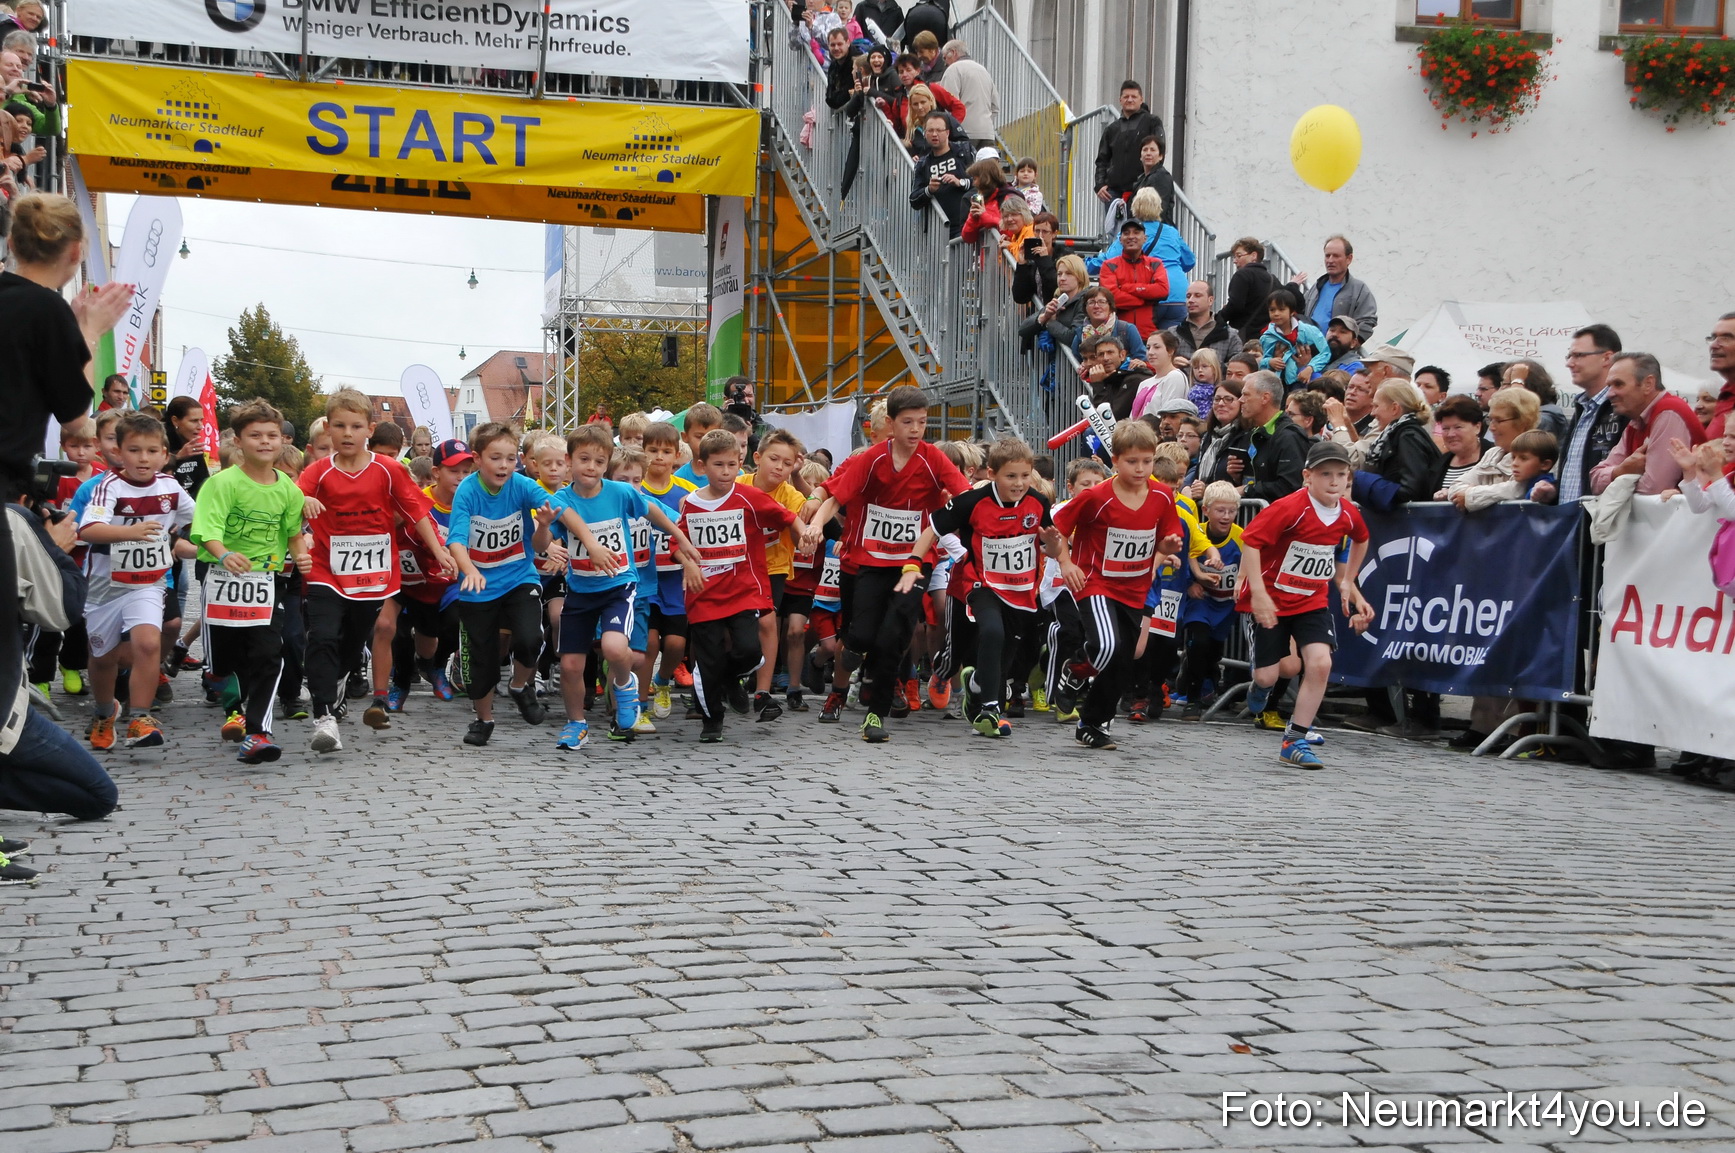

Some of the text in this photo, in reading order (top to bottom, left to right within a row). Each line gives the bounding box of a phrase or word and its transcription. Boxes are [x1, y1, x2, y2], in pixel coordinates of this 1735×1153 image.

[367, 23, 469, 46] Verbrauch.
[475, 31, 523, 50] Mehr
[108, 113, 265, 138] Neumarkter Stadtlauf
[306, 101, 542, 167] START
[582, 149, 722, 167] Neumarkter Stadtlauf
[930, 157, 957, 179] 952
[547, 187, 676, 205] Neumarkter Stadtlauf
[129, 281, 149, 330] BKK
[1488, 325, 1524, 337] UNS
[427, 417, 441, 444] BKK
[1089, 413, 1108, 437] BMW
[470, 519, 490, 530] PARTL
[707, 515, 735, 523] Neumarkt
[868, 508, 913, 521] PARTL Neumarkt
[475, 524, 520, 549] 7036
[693, 523, 742, 546] 7034
[870, 518, 916, 542] 7025
[1108, 531, 1129, 539] PARTL
[1002, 540, 1028, 550] Neumarkt
[1290, 544, 1311, 555] PARTL
[118, 545, 167, 569] 7051
[338, 547, 385, 571] 7211
[987, 546, 1032, 571] 7137
[1290, 553, 1333, 577] 7008
[209, 569, 231, 578] PARTL
[356, 576, 372, 585] Erik
[214, 579, 269, 604] 7005
[229, 608, 248, 618] Max
[1380, 584, 1514, 636] Fischer
